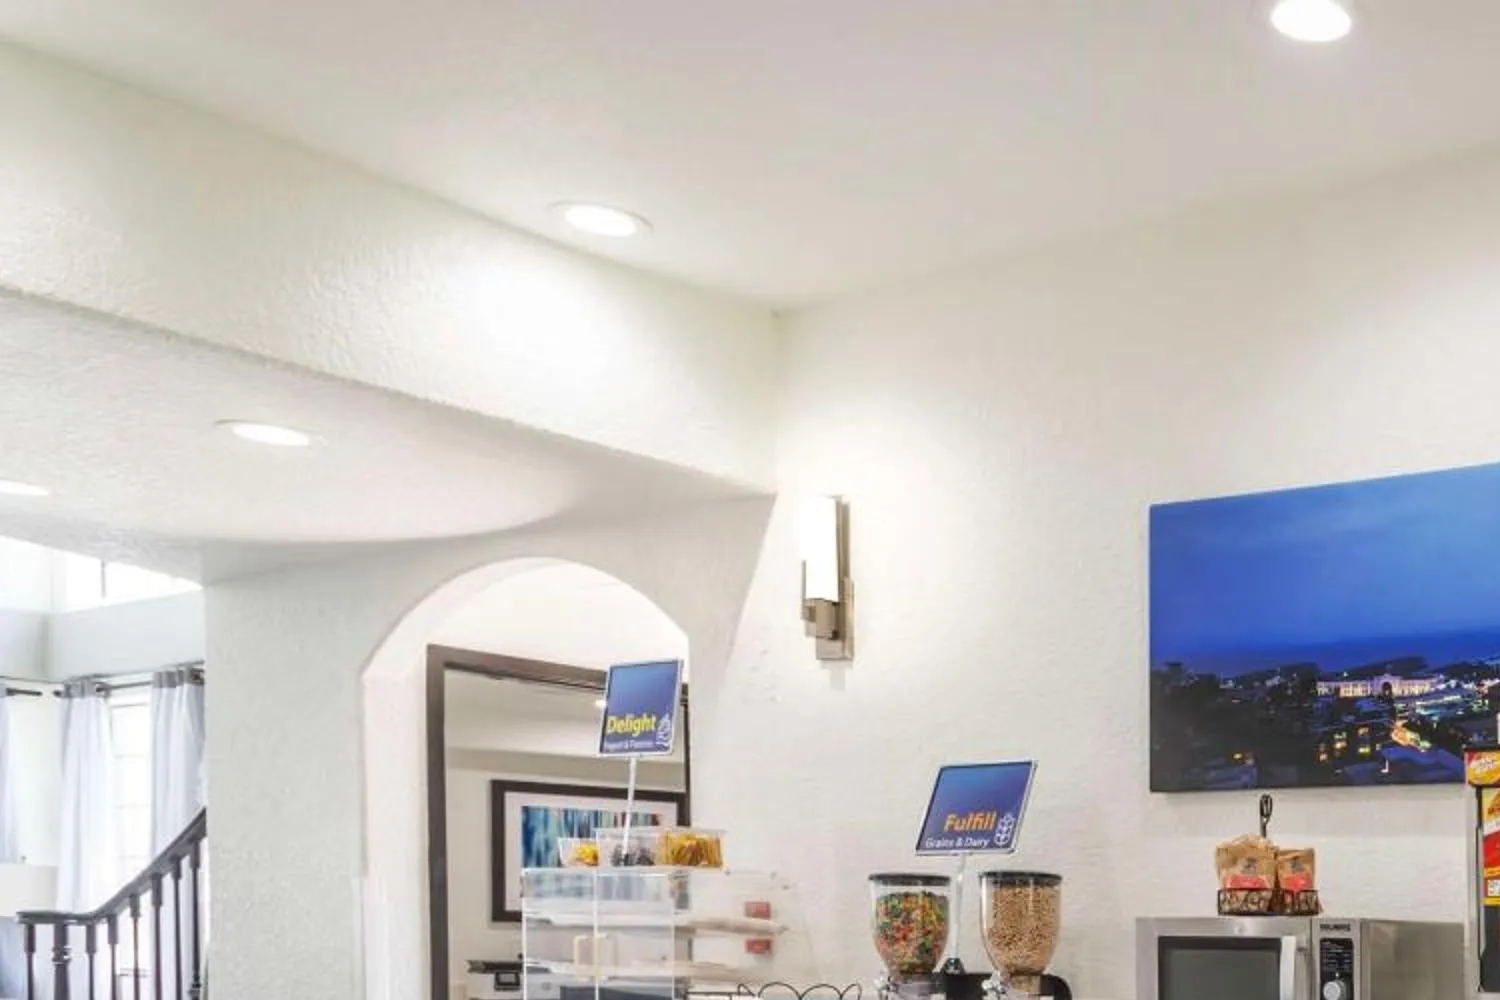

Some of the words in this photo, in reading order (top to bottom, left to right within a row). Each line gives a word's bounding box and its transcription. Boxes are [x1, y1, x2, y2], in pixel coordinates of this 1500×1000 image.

[606, 714, 657, 737] Delight
[943, 810, 997, 833] Fulfill
[924, 837, 954, 849] Grains
[964, 836, 990, 849] Dairy
